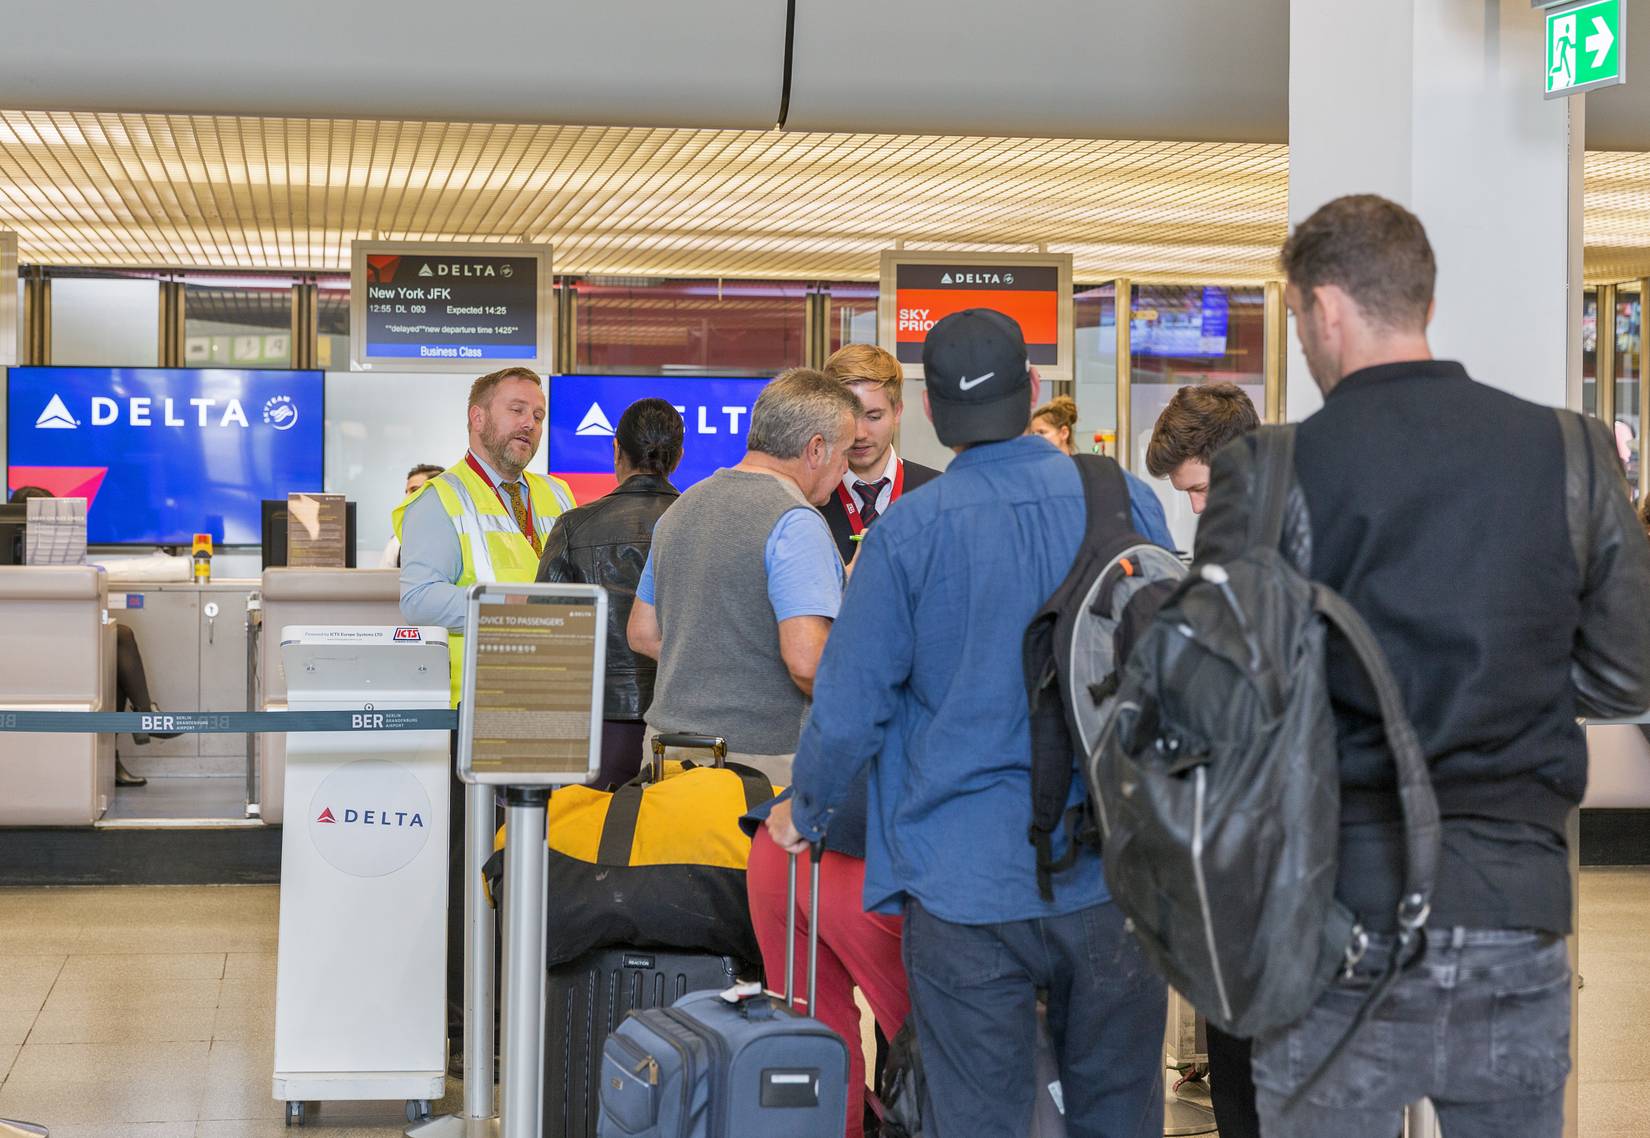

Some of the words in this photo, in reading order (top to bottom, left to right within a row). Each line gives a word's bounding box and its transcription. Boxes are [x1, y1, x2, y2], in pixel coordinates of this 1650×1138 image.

[438, 264, 495, 277] DELTA
[956, 273, 1000, 283] DELTA
[369, 287, 395, 299] New
[397, 288, 425, 300] York
[427, 288, 451, 300] JFK
[369, 304, 392, 313] 12:55
[395, 305, 407, 313] DL
[411, 305, 426, 314] 093
[446, 306, 483, 315] Expected
[485, 307, 507, 315] 14:25
[899, 309, 930, 320] SKY
[441, 326, 476, 335] departure
[477, 326, 493, 334] time
[899, 320, 940, 332] PRIO
[420, 346, 457, 357] Business
[459, 347, 482, 358] Class
[91, 396, 249, 428] DELTA
[479, 615, 505, 625] DVICE
[506, 616, 517, 625] TO
[518, 617, 565, 626] PASSENGERS
[397, 629, 418, 638] ICTS
[141, 715, 174, 730] BER
[352, 714, 384, 729] BER
[344, 809, 424, 828] DELTA
